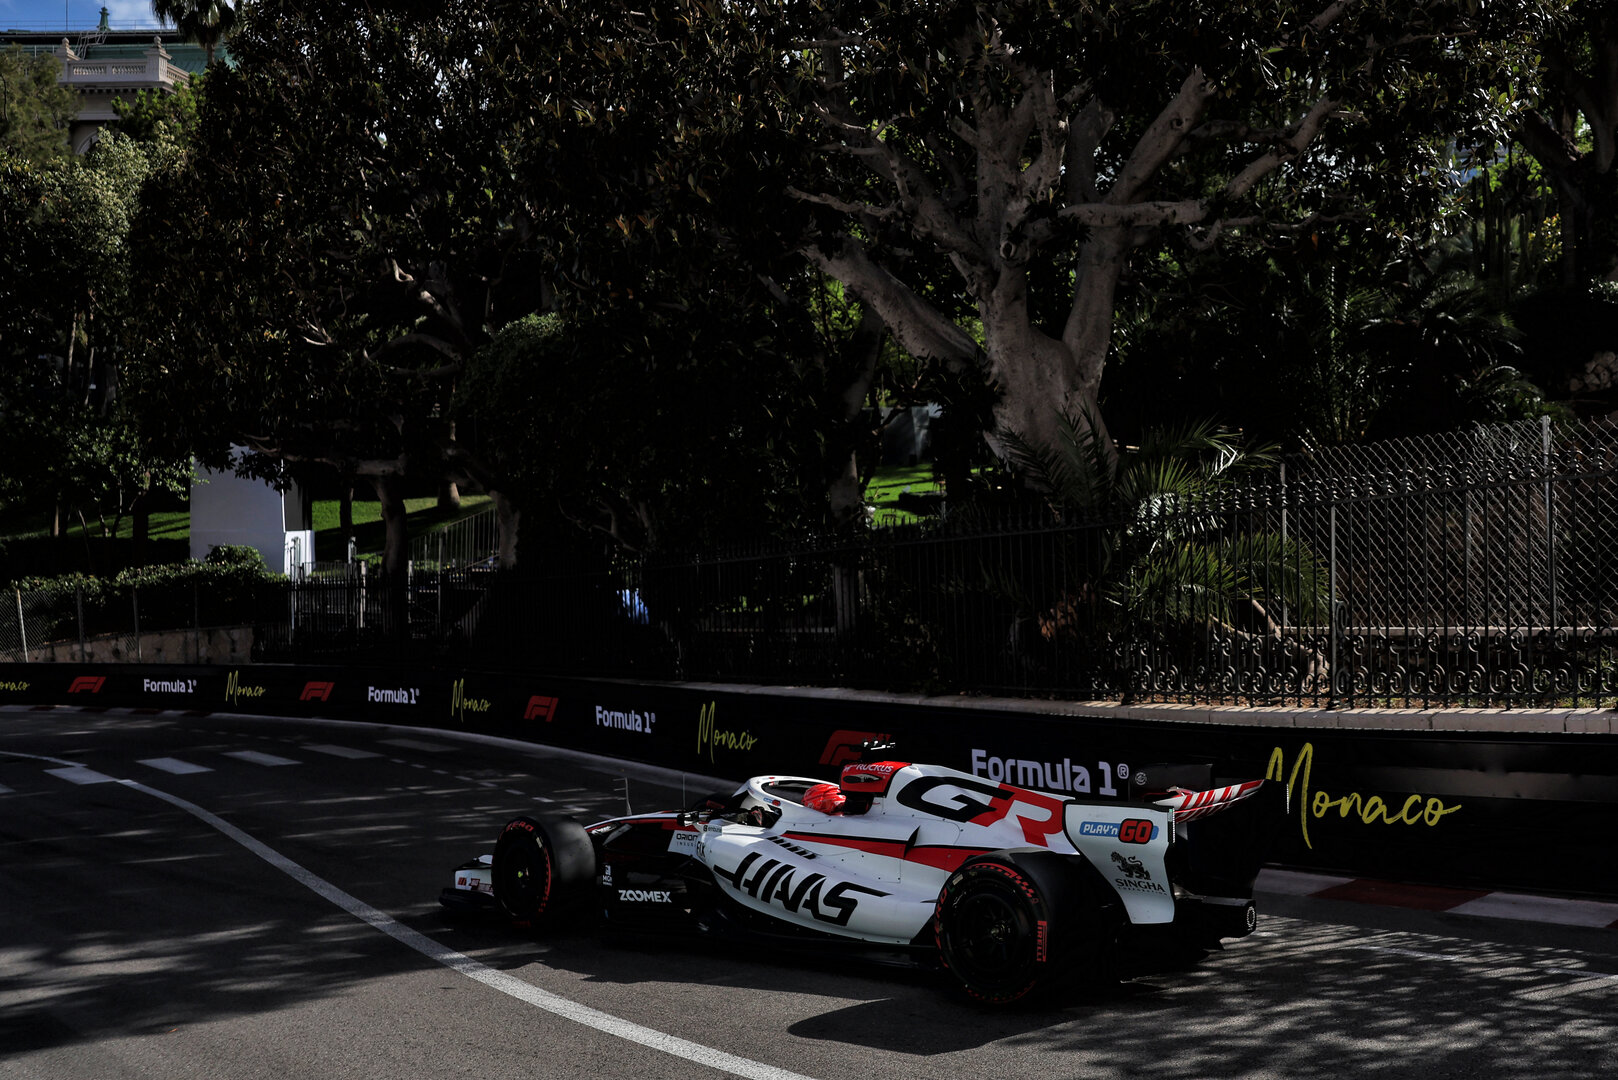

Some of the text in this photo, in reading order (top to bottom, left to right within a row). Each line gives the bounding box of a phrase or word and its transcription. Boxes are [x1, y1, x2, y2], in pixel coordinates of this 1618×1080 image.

[0, 681, 31, 692] onaco
[68, 676, 106, 693] F1
[143, 678, 186, 693] Formula
[225, 670, 266, 706] Monaco
[300, 681, 335, 701] F1
[367, 686, 409, 704] Formula
[451, 678, 491, 722] Monaco
[523, 695, 559, 722] F1
[595, 705, 643, 733] Formula
[697, 701, 758, 764] Monaco
[856, 763, 894, 773] RUCKUS
[971, 748, 1091, 794] Formula
[1265, 742, 1462, 849] Monaco
[1119, 819, 1153, 844] GO
[618, 889, 672, 903] ZOOMEX
[713, 851, 893, 927] HAAS
[1115, 878, 1166, 892] SINGHA
[1037, 920, 1048, 962] PIRELLI
